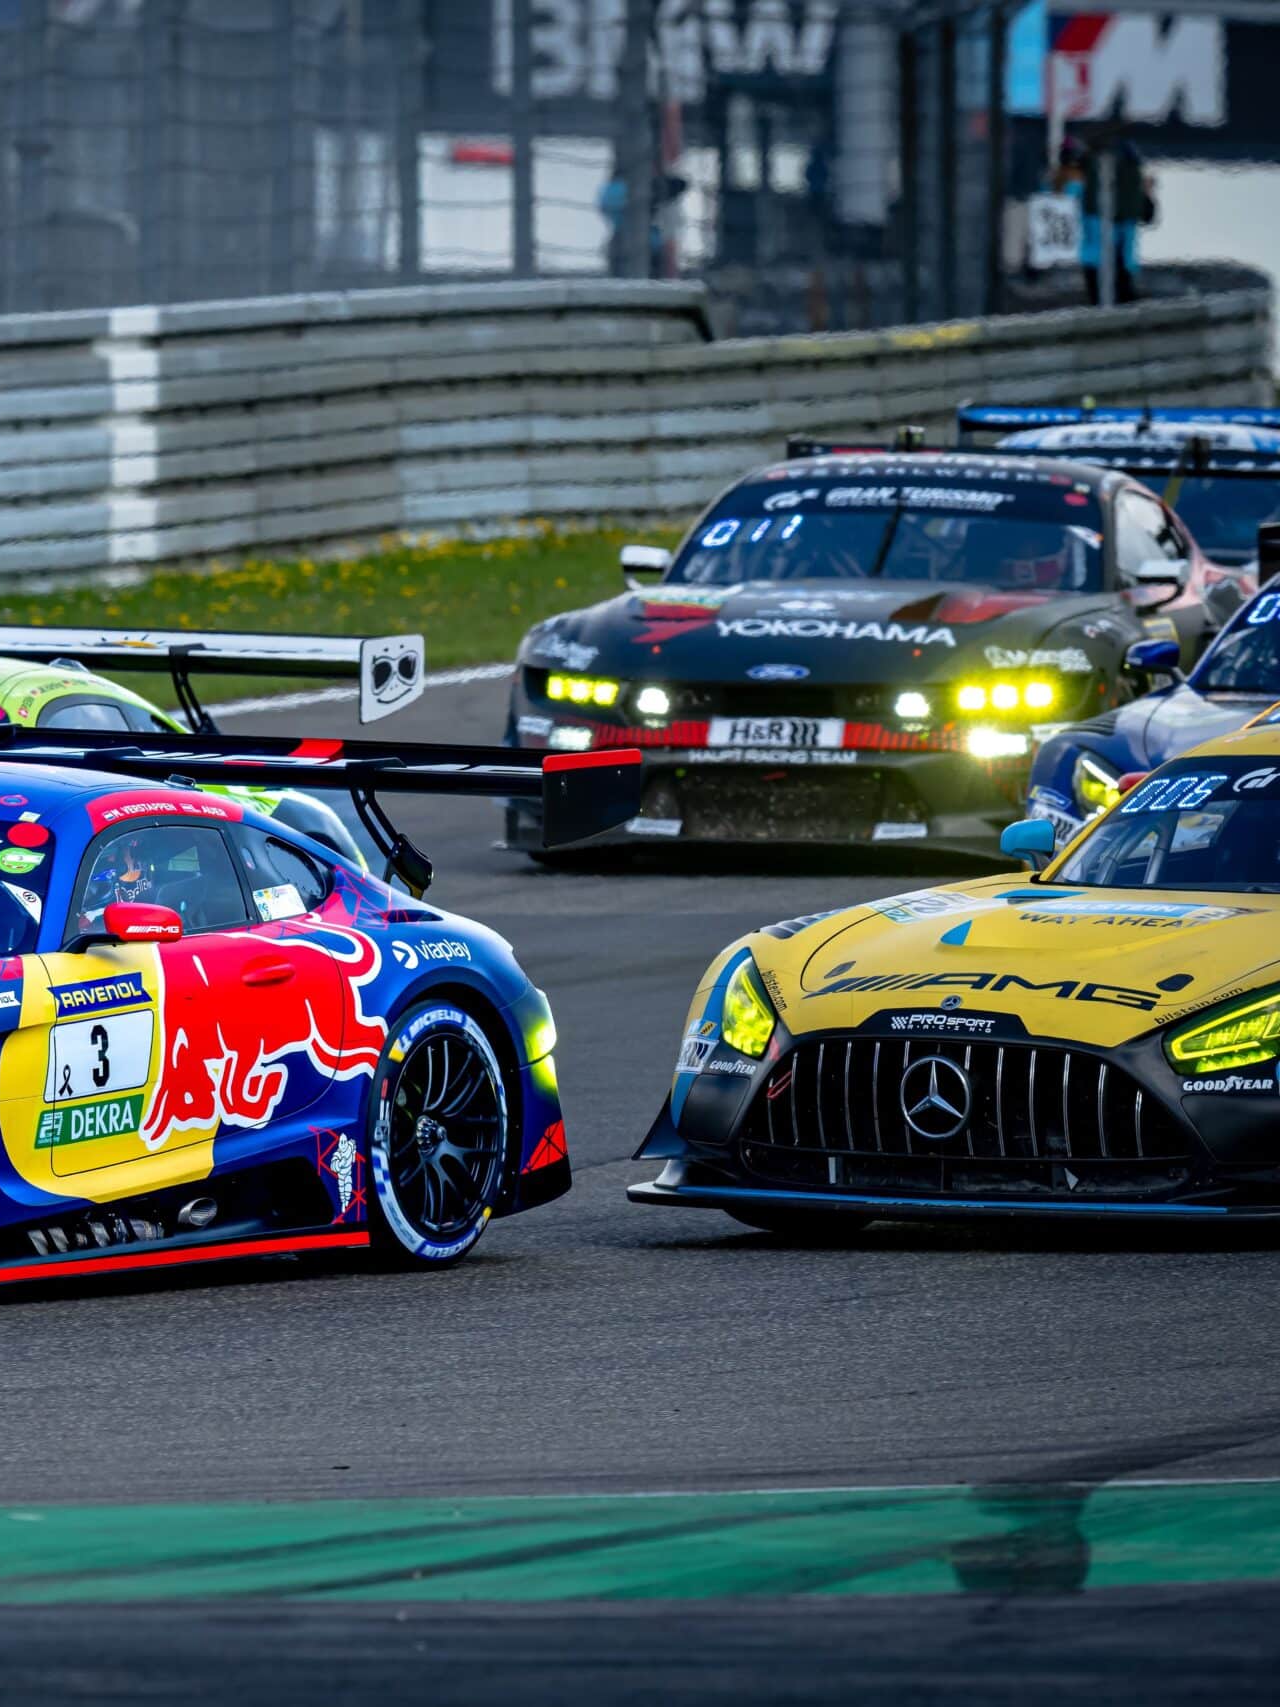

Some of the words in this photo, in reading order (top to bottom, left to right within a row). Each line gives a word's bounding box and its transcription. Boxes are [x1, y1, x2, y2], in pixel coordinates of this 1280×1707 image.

[701, 514, 804, 547] 011
[717, 618, 958, 648] YOKOHAMA
[727, 722, 783, 742] H&R
[745, 751, 808, 763] RACING
[811, 751, 857, 764] TEAM
[1120, 775, 1228, 813] 006
[1019, 912, 1083, 925] WAY
[414, 939, 472, 961] viaplay
[60, 981, 142, 1009] RAVENOL
[1153, 986, 1244, 1025] bilstein.com
[409, 1009, 464, 1037] MICHELIN
[90, 1024, 110, 1087] 3
[709, 1059, 757, 1075] GOODYEAR
[1183, 1075, 1274, 1092] GOODYEAR
[70, 1100, 135, 1140] DEKRA
